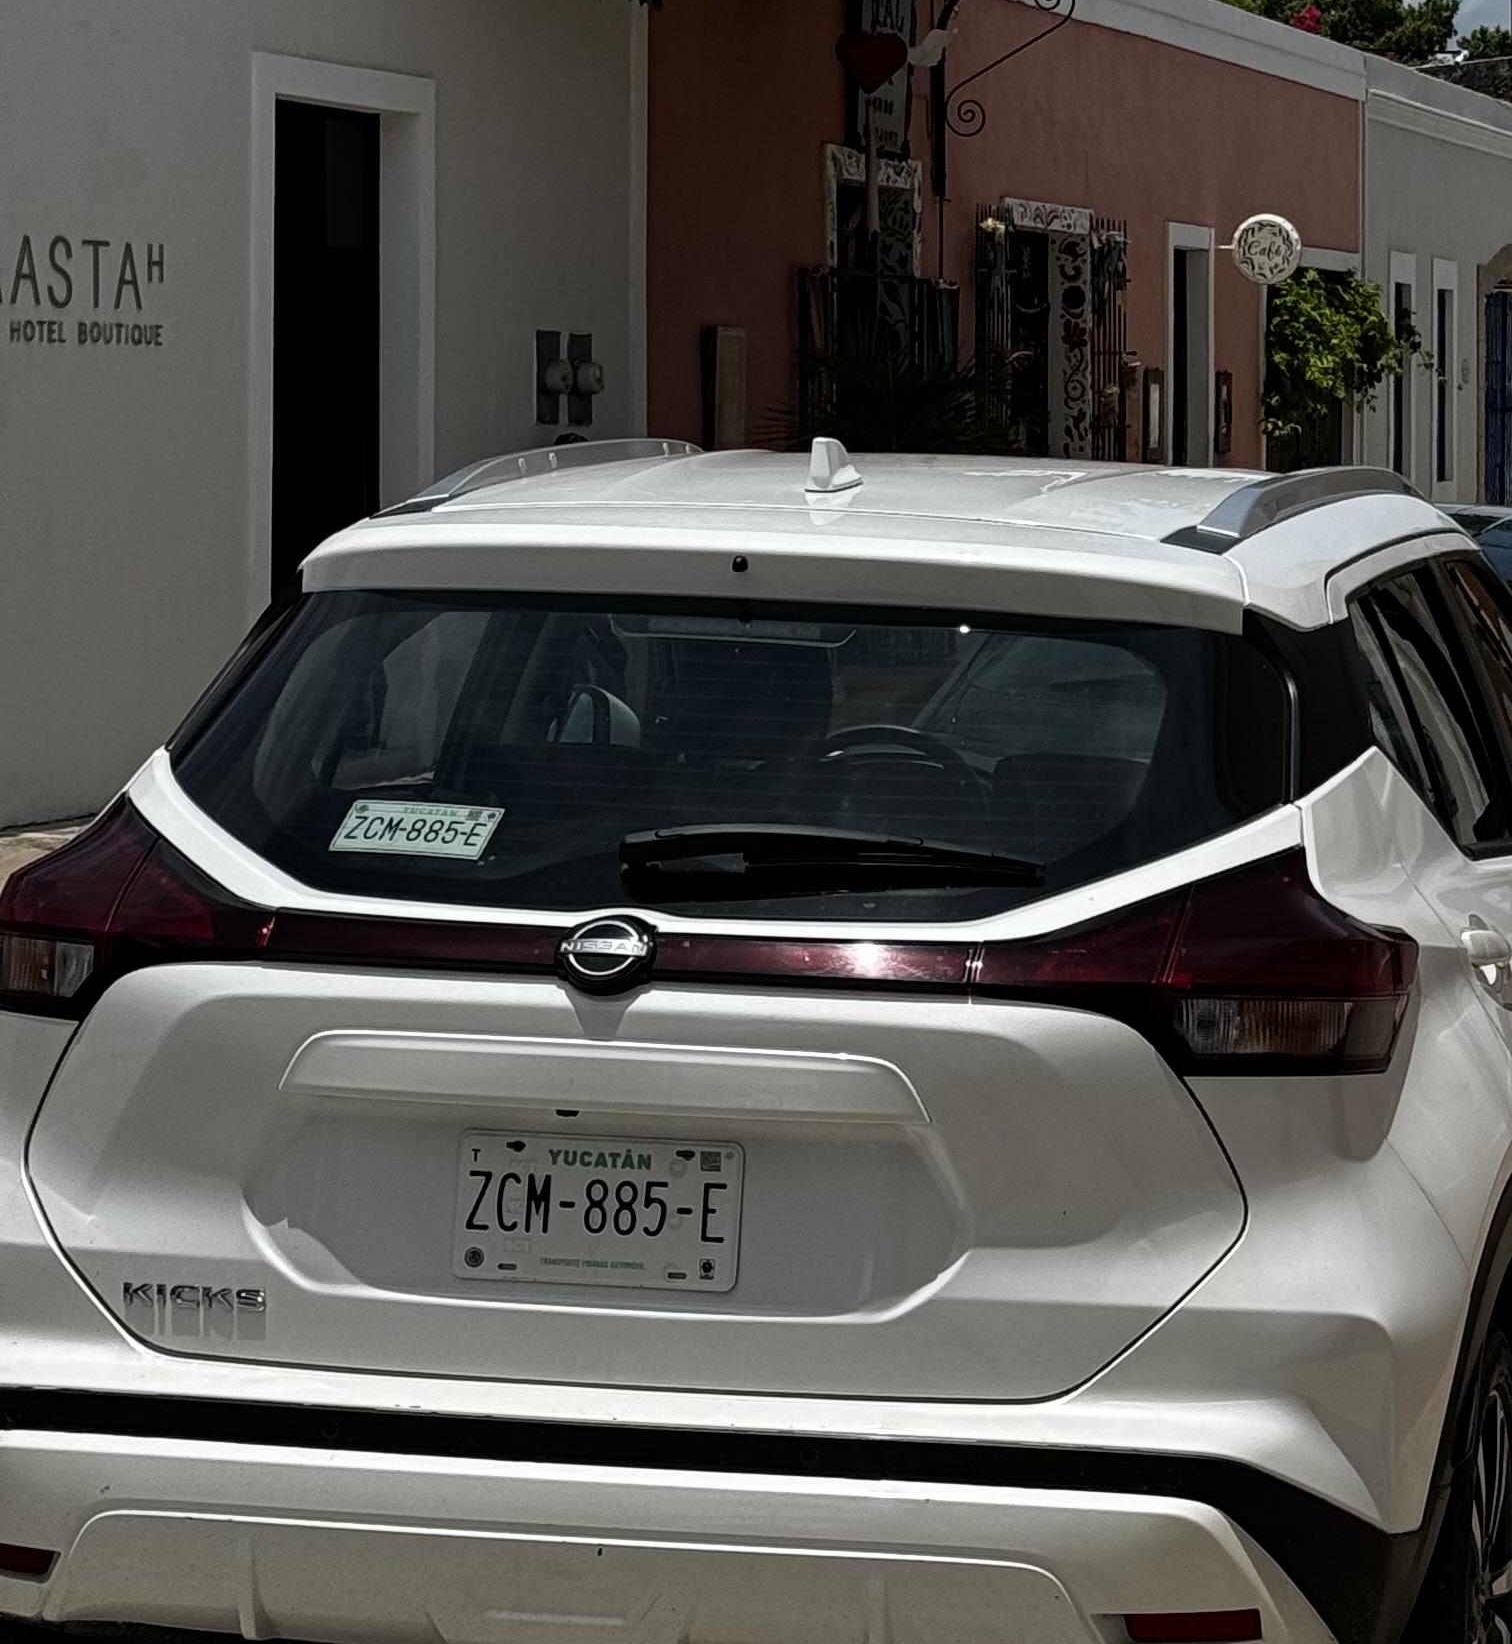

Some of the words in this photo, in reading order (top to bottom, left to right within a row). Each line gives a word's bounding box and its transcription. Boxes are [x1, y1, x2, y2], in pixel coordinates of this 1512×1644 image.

[0, 234, 164, 312] ASTAH
[9, 319, 67, 345] HOTEL
[77, 320, 164, 347] BOUTIQUE
[343, 815, 487, 847] ZCM-885-E
[560, 940, 648, 957] NISSAN
[471, 1148, 481, 1163] T
[465, 1169, 728, 1244] ZCM-885-E
[123, 1282, 266, 1313] KICKS
